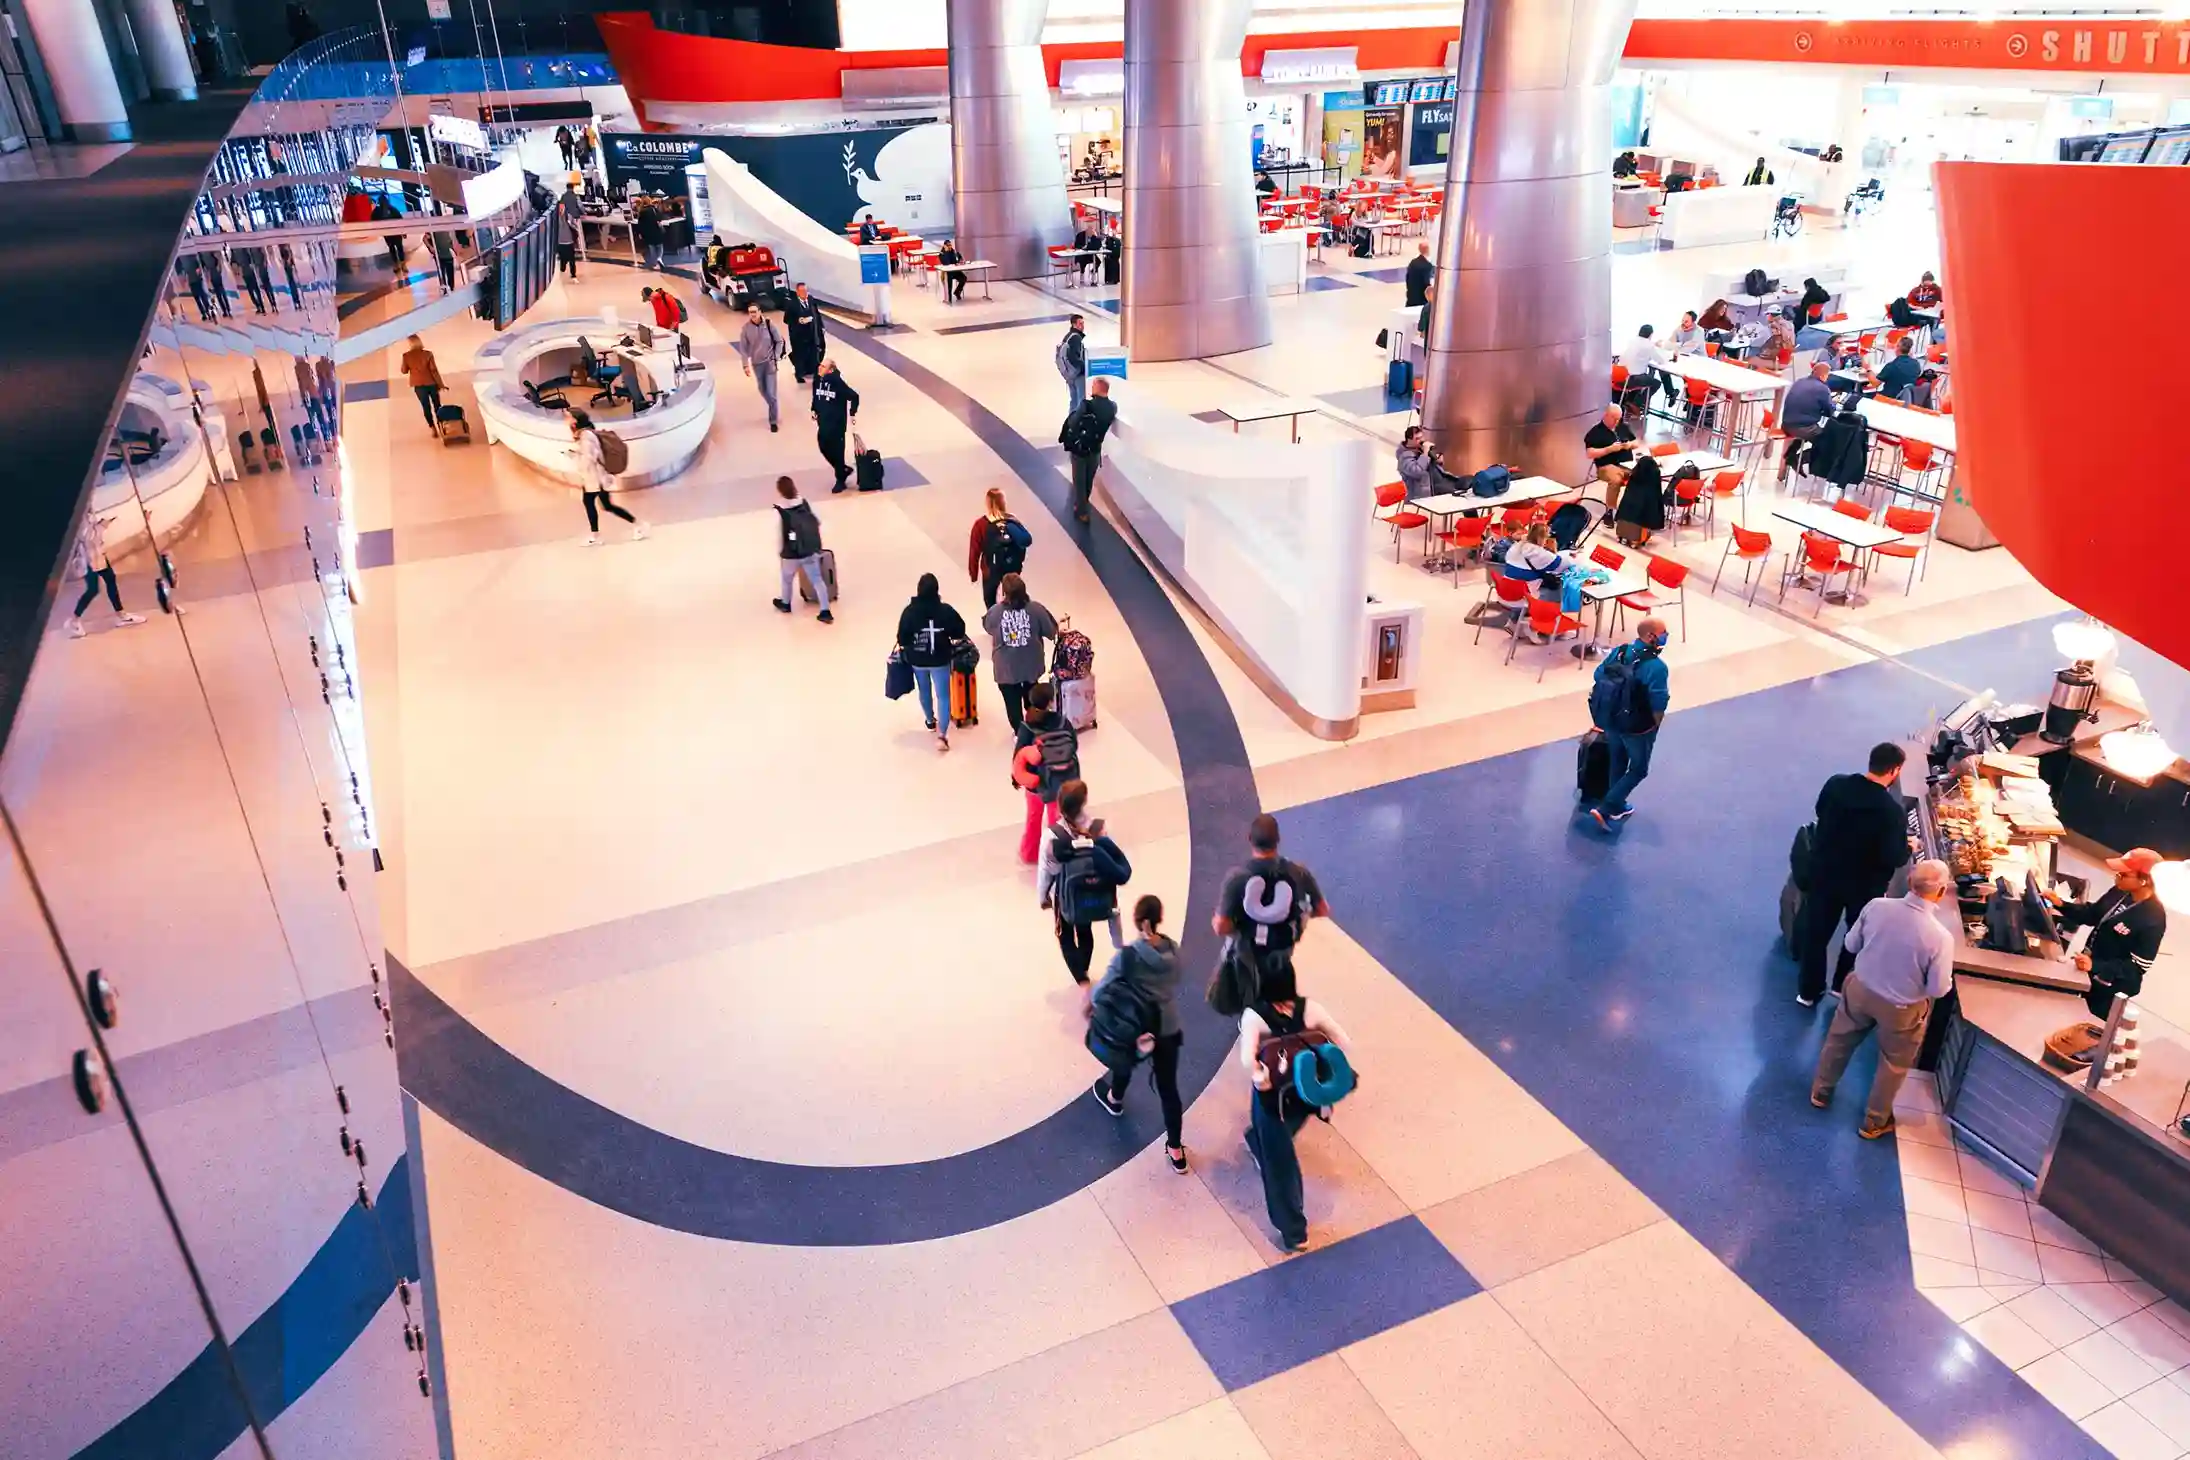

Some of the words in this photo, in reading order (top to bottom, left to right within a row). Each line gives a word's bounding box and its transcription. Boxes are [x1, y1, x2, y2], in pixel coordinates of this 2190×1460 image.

[2042, 29, 2190, 65] SHUTT
[1366, 117, 1385, 126] YUM!
[640, 141, 689, 153] COLOMBE
